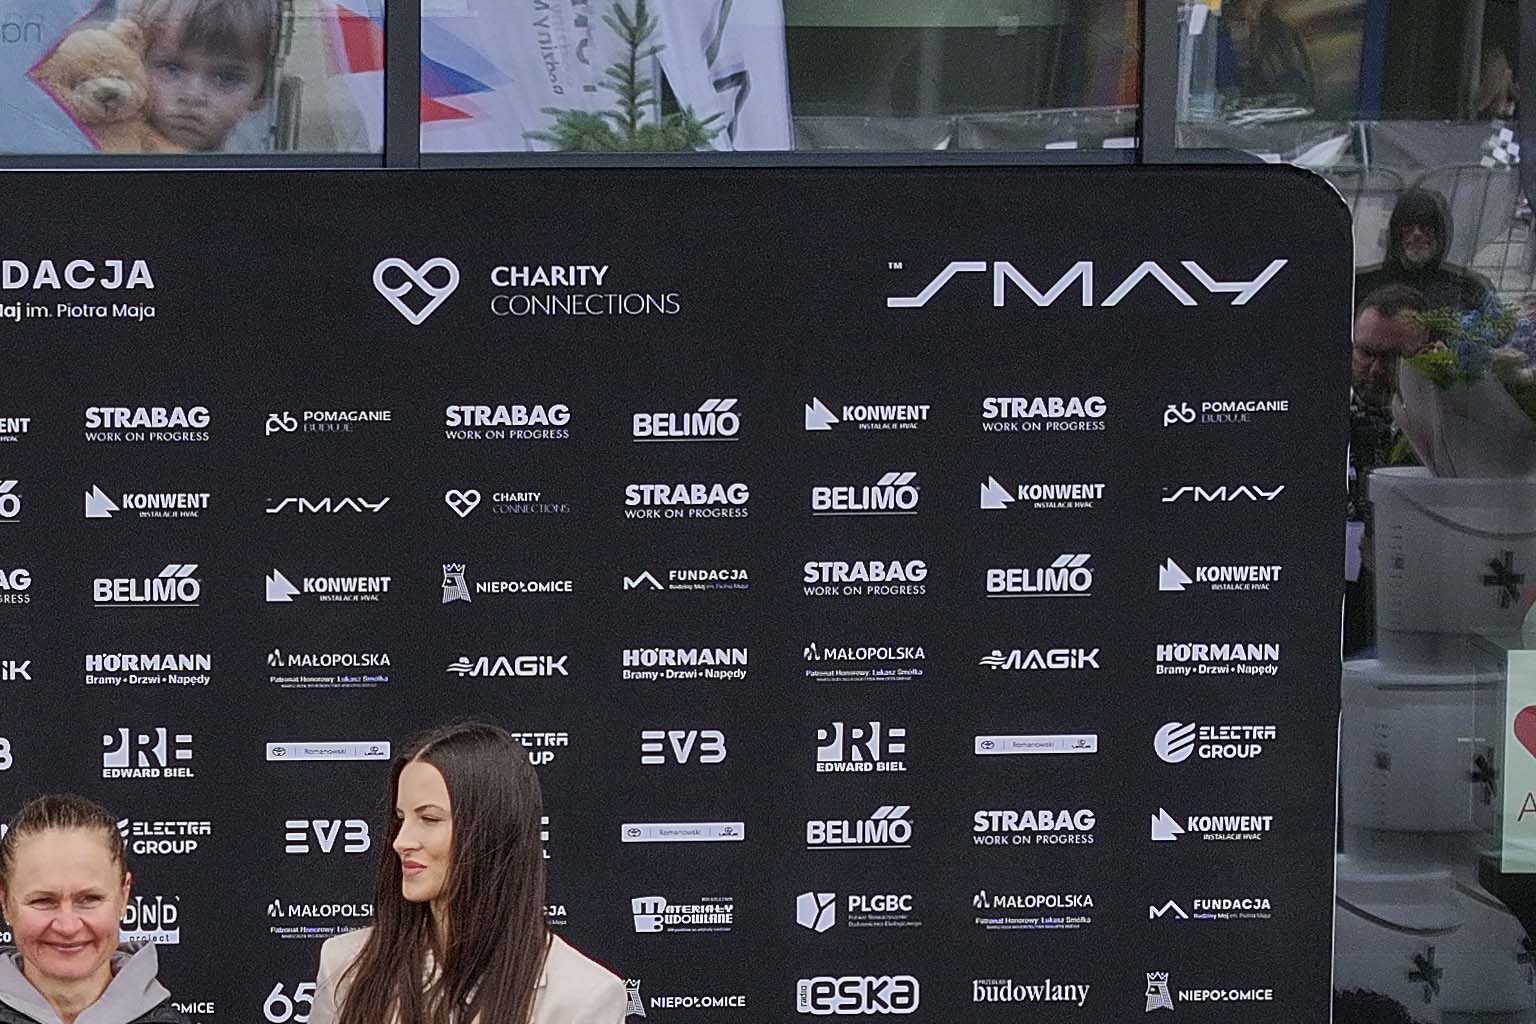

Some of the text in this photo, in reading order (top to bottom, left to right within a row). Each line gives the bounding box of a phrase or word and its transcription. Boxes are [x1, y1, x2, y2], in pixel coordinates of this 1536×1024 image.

[490, 265, 609, 287] CHARITY
[887, 259, 1289, 308] SMAY
[26, 302, 53, 318] im.
[57, 302, 108, 318] Piotra
[112, 302, 156, 322] Maja
[490, 292, 680, 316] CONNECTIONS
[445, 403, 571, 427] STRABAG
[842, 404, 931, 421] KONWENT
[982, 395, 1107, 419] STRABAG
[1201, 400, 1289, 413] POMAGANIE
[303, 410, 392, 422] POMAGANIE
[632, 411, 739, 437] BELIMO
[492, 492, 541, 502] CHARITY
[624, 482, 750, 506] STRABAG
[1161, 485, 1285, 503] SMAY
[669, 569, 749, 581] FUNDACJA
[93, 578, 199, 602] BELIMO
[1156, 642, 1280, 662] HÖRMANN
[85, 652, 211, 672] HÖRMANN
[85, 674, 211, 687] Bramy Drzwi Napędy
[1199, 725, 1276, 740] ELECTRA
[1198, 743, 1262, 759] GROUP
[816, 761, 907, 773] EDWARD BIEL
[973, 808, 1096, 832] STRABAG
[1187, 815, 1273, 832] KONWENT
[972, 833, 1094, 845] WORK ON PROGRESS
[848, 894, 913, 912] PLGBC
[993, 894, 1094, 909] MAŁOPOLSKA
[1193, 898, 1271, 910] FUNDACJA
[972, 978, 1090, 1007] budowlany
[1178, 988, 1273, 1002] NIEPOŁOMICE
